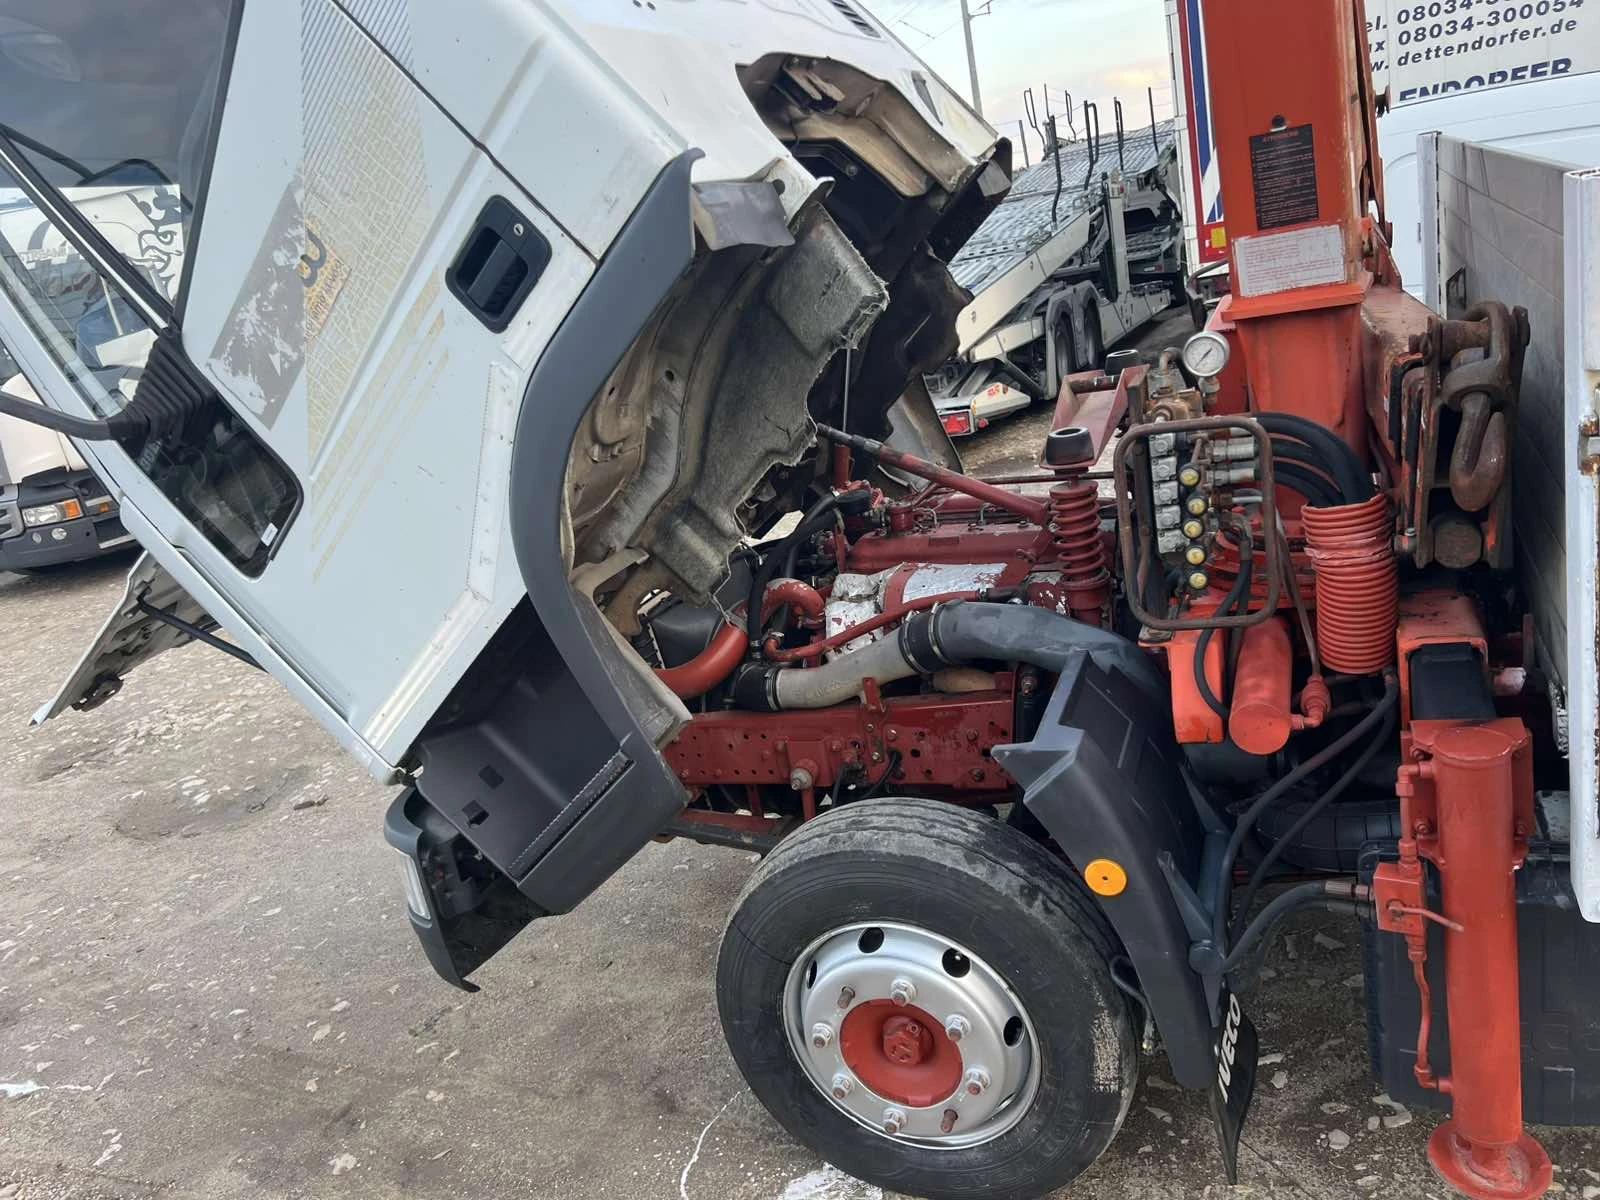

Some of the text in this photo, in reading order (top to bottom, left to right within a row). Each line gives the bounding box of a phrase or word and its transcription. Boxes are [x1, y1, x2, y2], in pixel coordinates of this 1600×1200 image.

[1366, 16, 1388, 33] el.
[1397, 18, 1577, 67] dettendorfer.de
[1218, 993, 1241, 1104] IVECO
